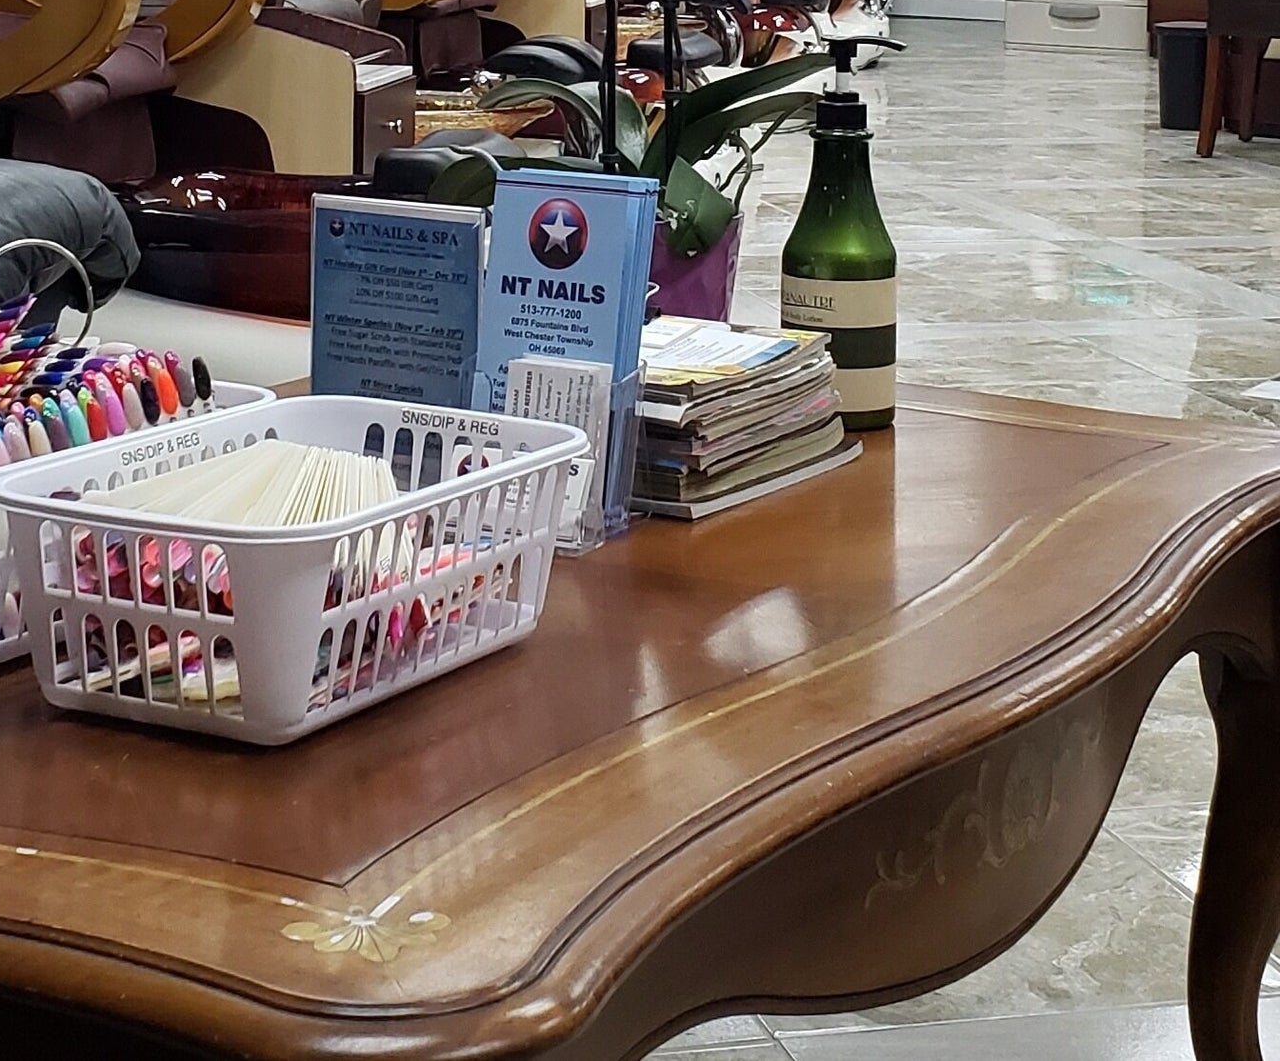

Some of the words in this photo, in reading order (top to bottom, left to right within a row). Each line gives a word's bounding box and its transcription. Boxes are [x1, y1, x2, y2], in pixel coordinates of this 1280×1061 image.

[349, 222, 368, 236] NT
[372, 224, 414, 241] NAILS
[417, 229, 428, 242] &
[432, 231, 459, 247] SPA
[501, 275, 532, 296] NT
[538, 279, 605, 304] NAILS
[520, 304, 582, 320] 513-777-1200
[504, 328, 522, 338] West
[524, 331, 554, 342] Chester
[556, 334, 594, 347] Township
[530, 319, 569, 331] Fountains
[571, 324, 589, 334] Blvd
[529, 343, 540, 353] OH
[401, 410, 455, 431] SNS/DIP
[458, 419, 466, 432] &
[470, 421, 499, 436] REG
[121, 442, 164, 466] SNS/DIP
[167, 439, 174, 453] &
[176, 432, 200, 450] REG
